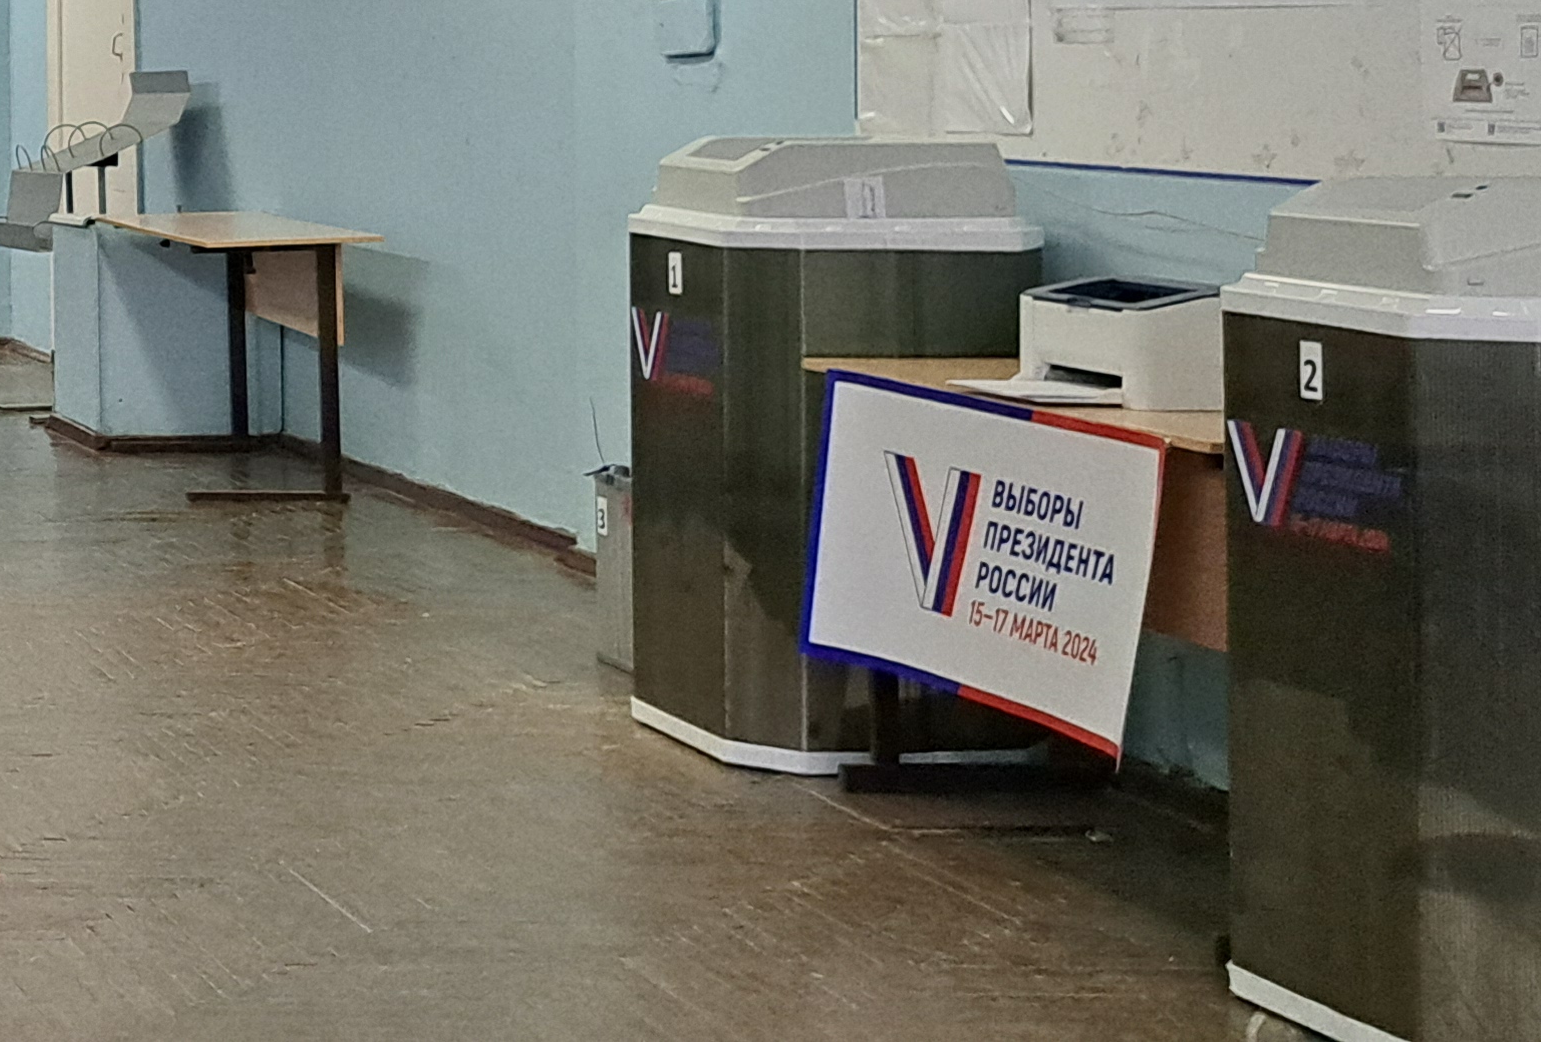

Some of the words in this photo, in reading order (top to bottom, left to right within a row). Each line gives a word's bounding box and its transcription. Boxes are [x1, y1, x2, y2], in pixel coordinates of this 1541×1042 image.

[1303, 359, 1318, 392] 2
[991, 479, 1084, 530] ВЫБОРЫ
[983, 521, 1115, 586] ПРЕЗИДЕНТА
[975, 561, 1057, 612] РОССИИ
[1009, 612, 1059, 653] МАРТА
[1061, 630, 1098, 666] 2024
